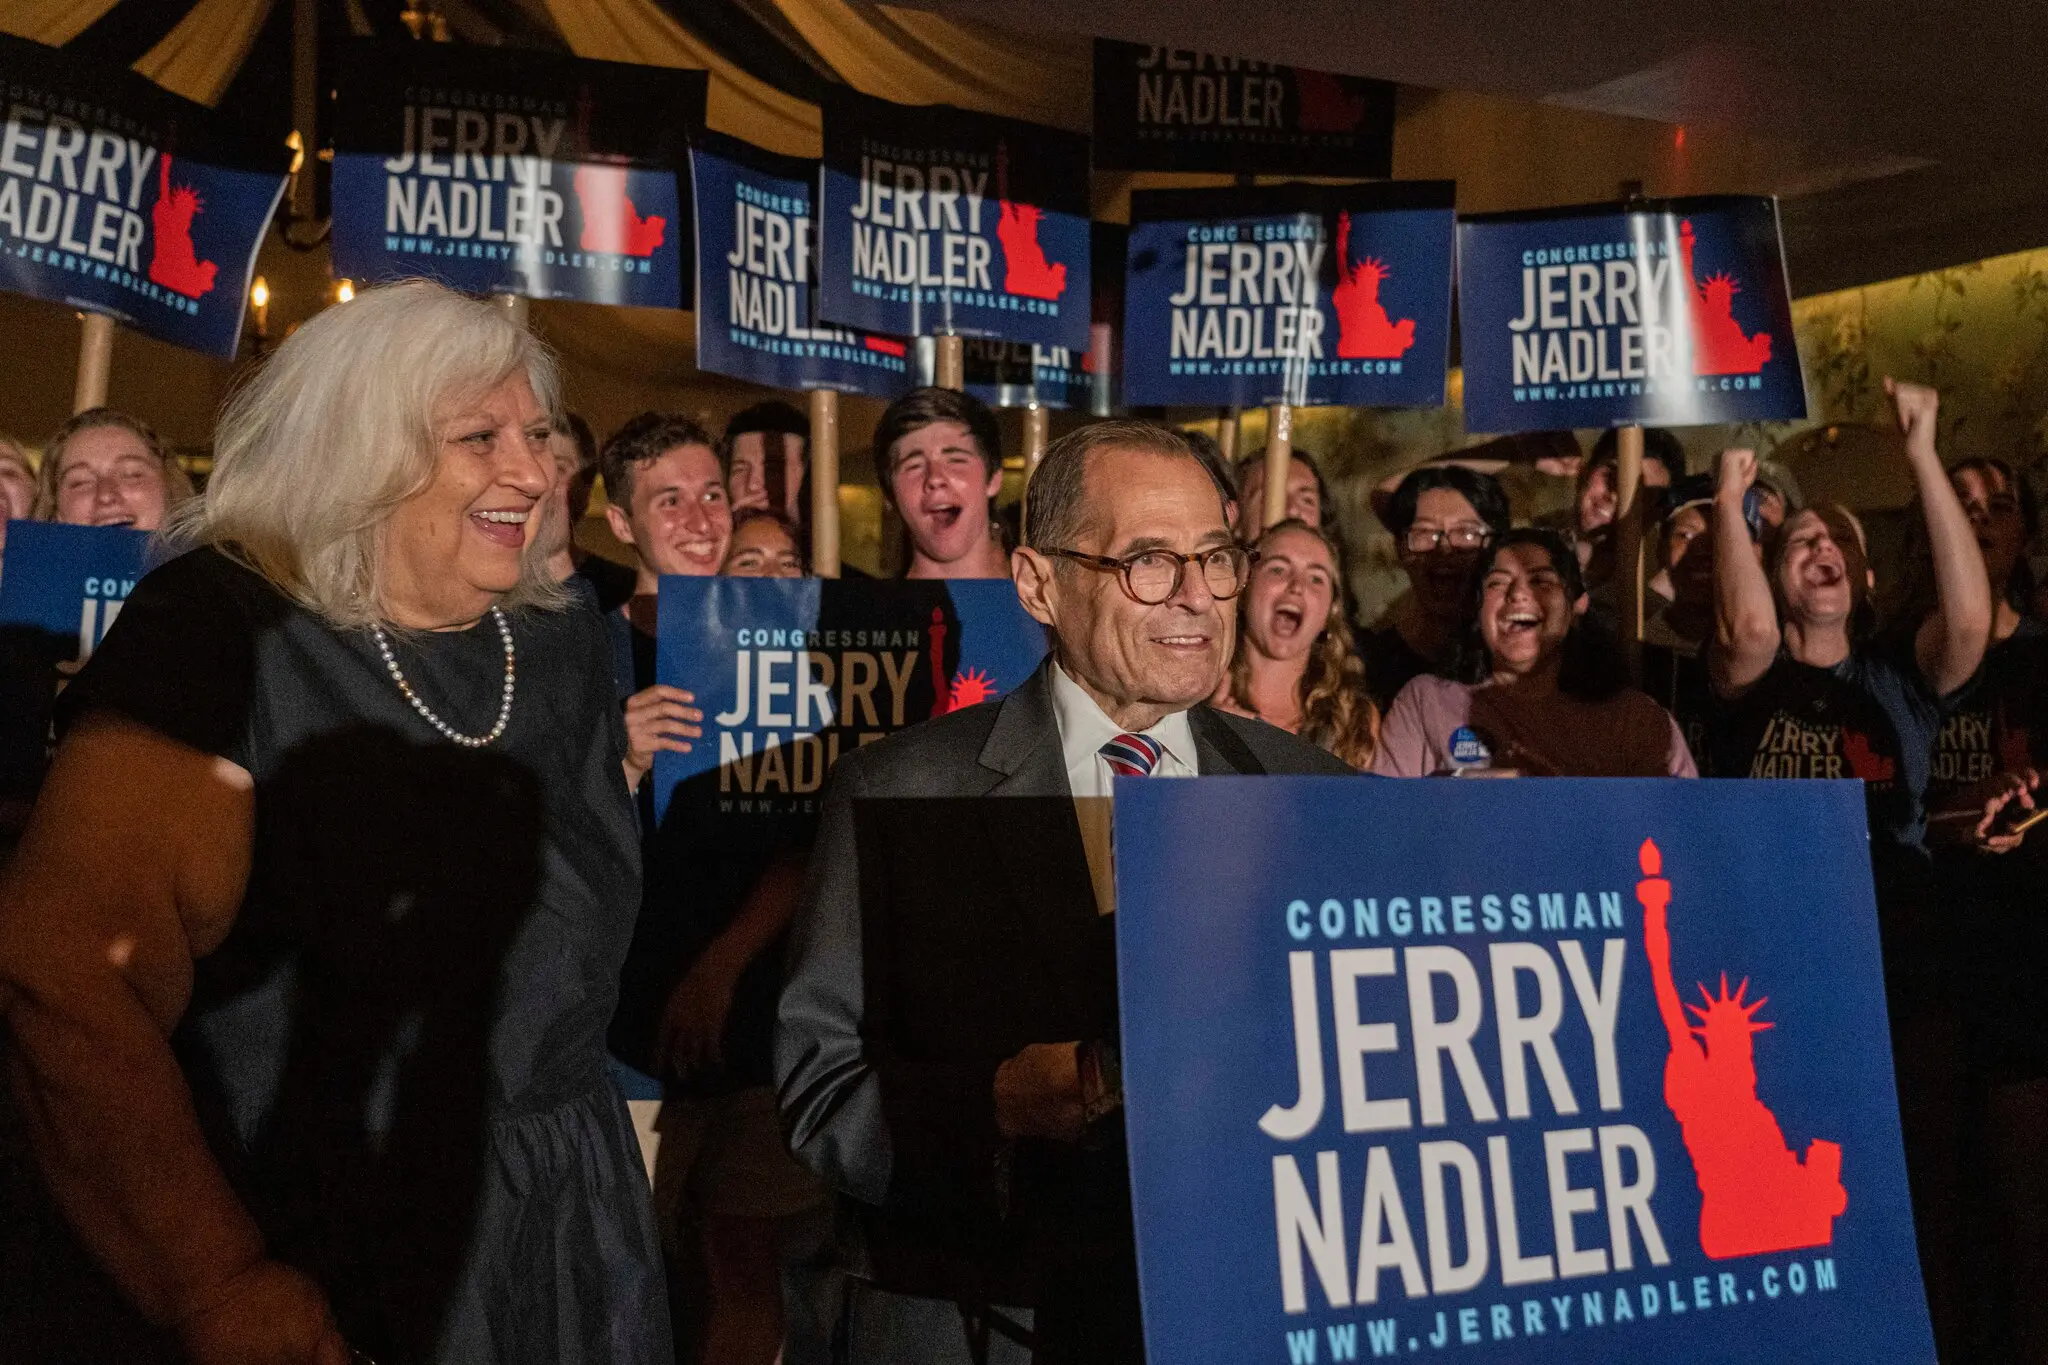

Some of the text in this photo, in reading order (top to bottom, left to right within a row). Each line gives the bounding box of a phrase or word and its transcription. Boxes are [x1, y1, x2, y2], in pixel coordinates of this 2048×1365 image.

[1136, 70, 1285, 128] NADLER
[0, 102, 157, 211] ERRY
[384, 105, 566, 186] JERRY
[0, 175, 145, 273] ADLER
[386, 175, 564, 247] NADLER
[850, 154, 989, 234] JERRY
[852, 221, 992, 291] NADLER
[1168, 241, 1327, 306] JERRY
[1522, 241, 1669, 266] CONGRESSMAN
[1508, 260, 1669, 331] JERRY
[1170, 306, 1326, 359] NADLER
[1512, 325, 1673, 386] NADLER
[738, 628, 921, 648] CONGRESSMAN
[714, 650, 919, 728] JERRY
[1939, 714, 1991, 751] RRY
[1286, 890, 1624, 939] CONGRESSMAN
[1256, 937, 1626, 1140] JERRY
[1272, 1123, 1671, 1314] NADLER
[1286, 1257, 1838, 1365] WWW.JERRYNADLER.COM
